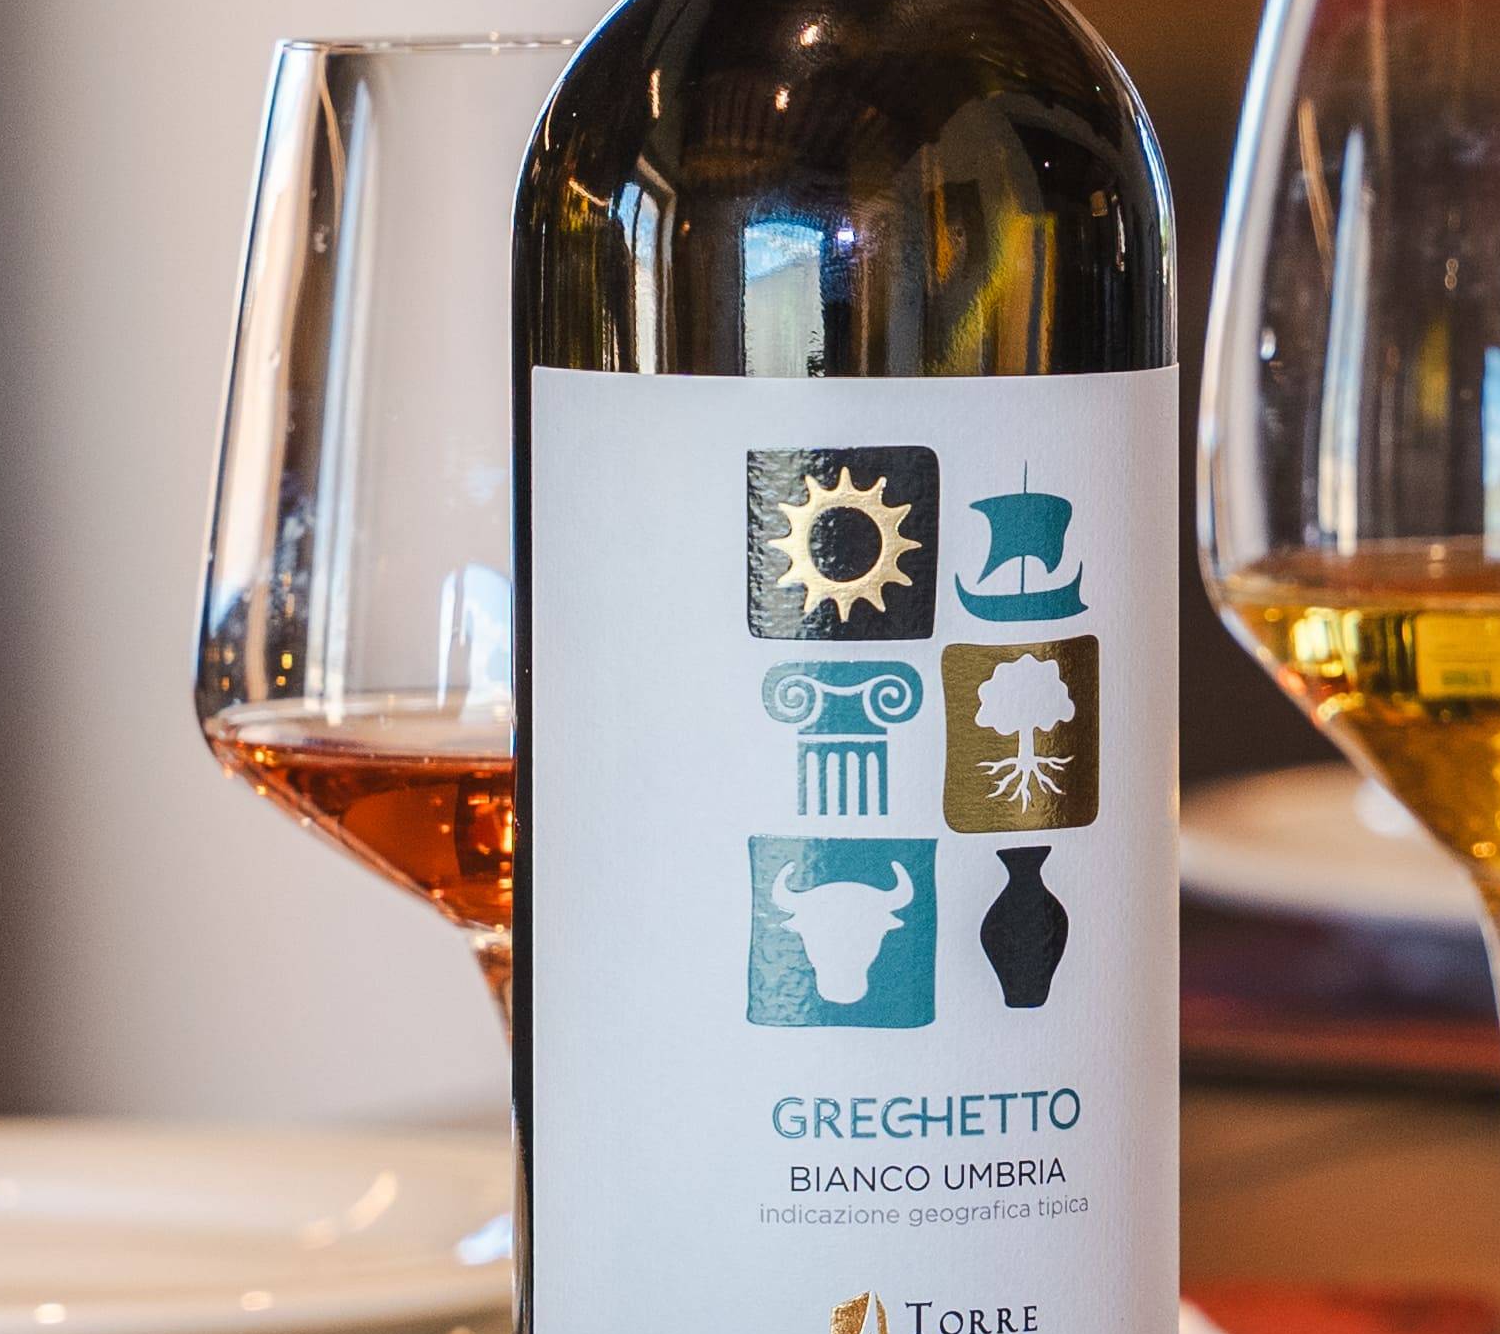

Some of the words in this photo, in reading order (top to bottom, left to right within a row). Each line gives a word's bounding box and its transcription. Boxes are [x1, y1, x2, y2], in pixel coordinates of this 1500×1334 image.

[772, 1087, 1081, 1139] GRECHETTO
[790, 1165, 930, 1193] BIANCO
[943, 1157, 1067, 1191] UMBRIA
[759, 1203, 900, 1226] indicazione
[908, 1200, 1030, 1228] geografica
[1038, 1194, 1089, 1218] tipica
